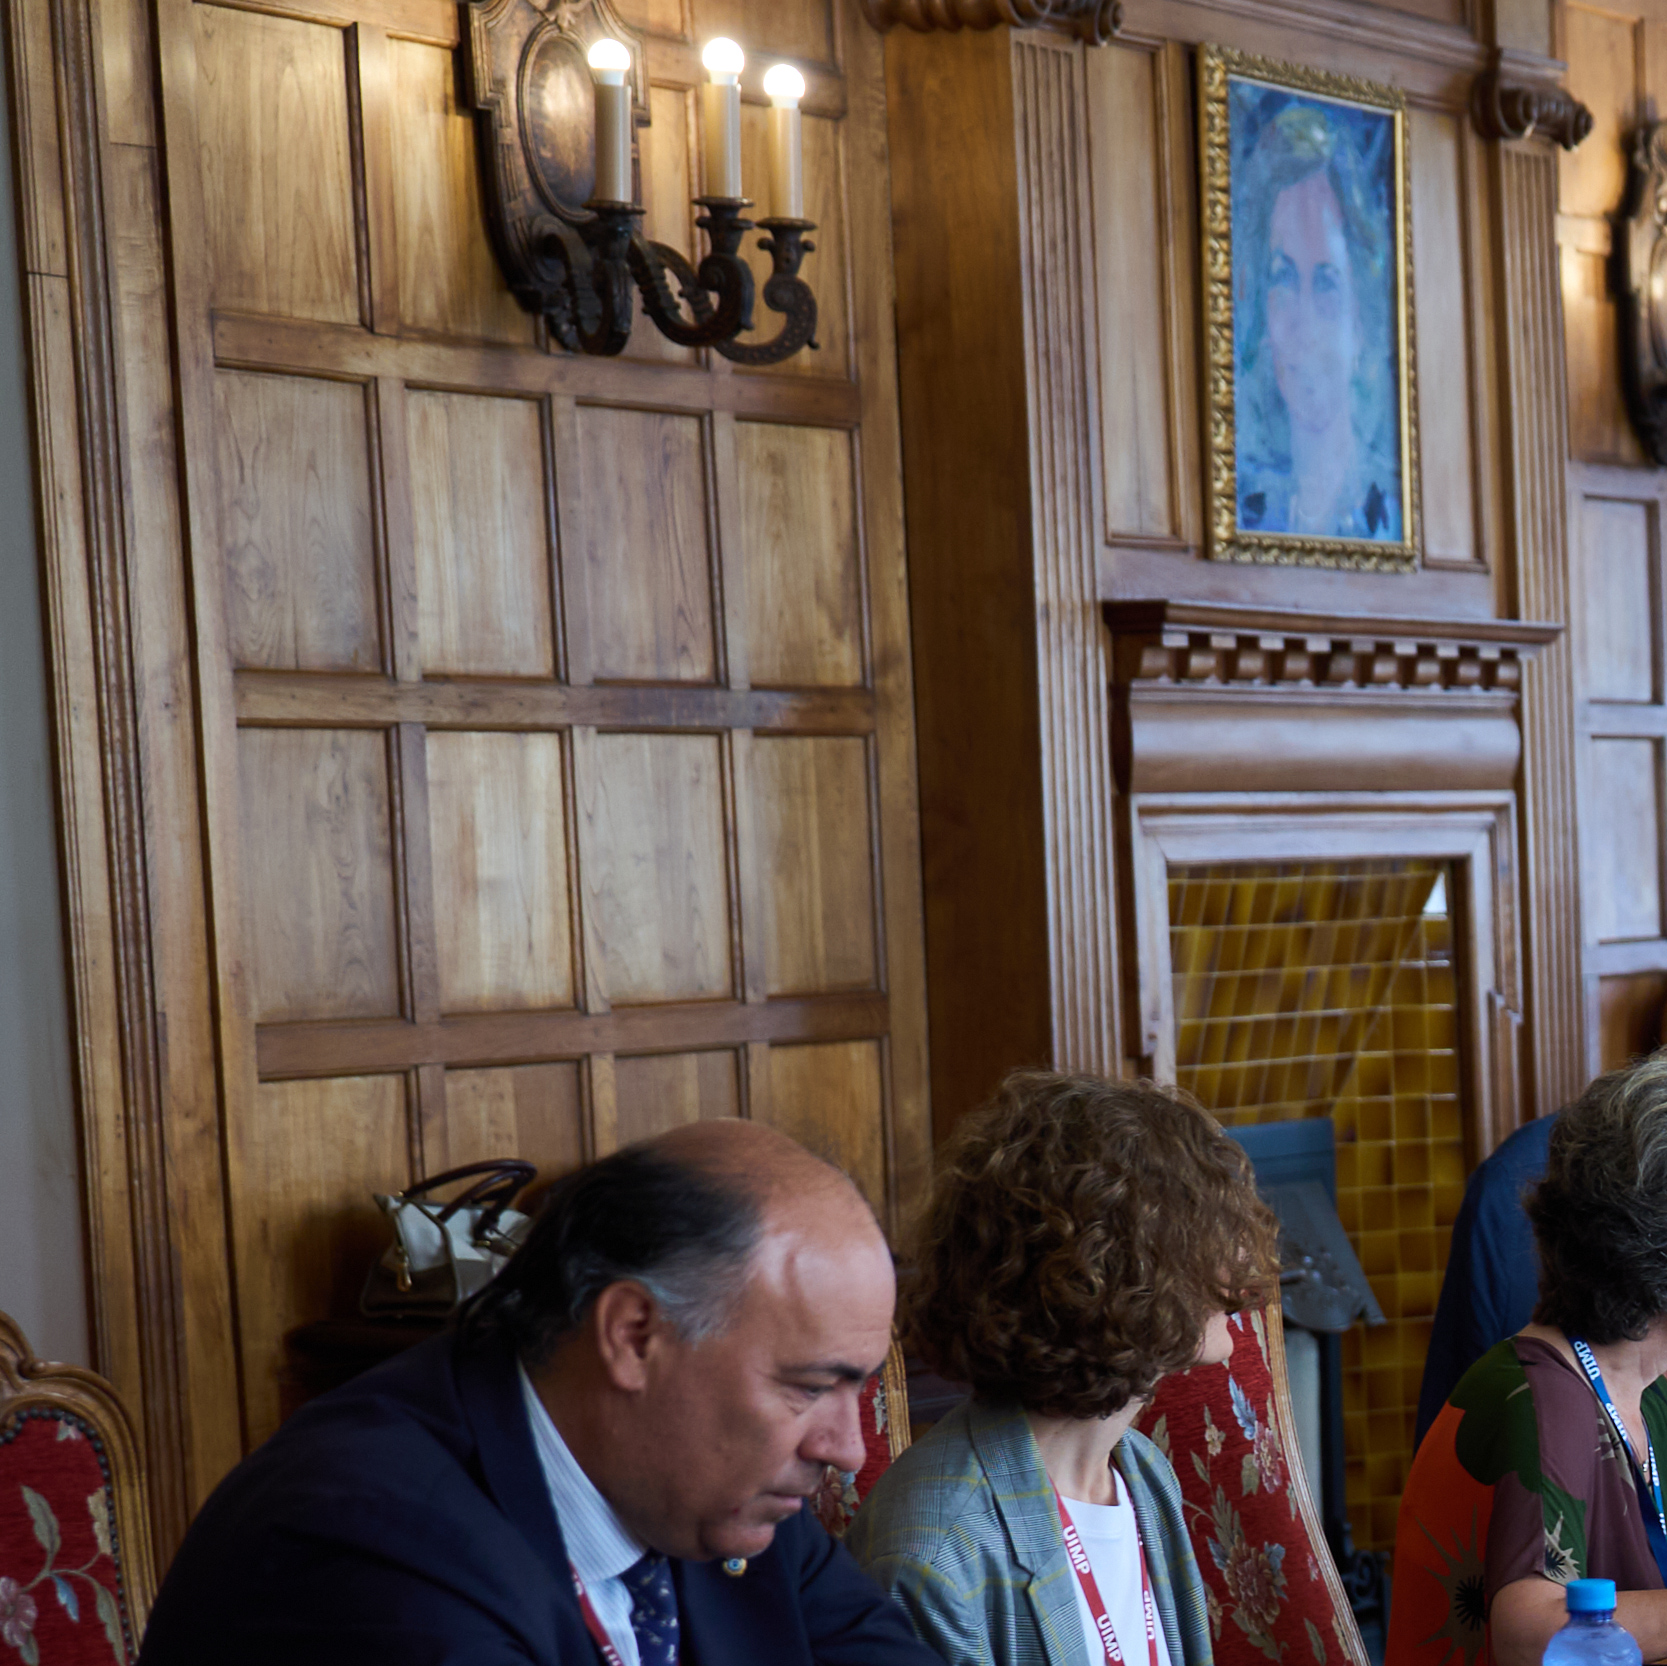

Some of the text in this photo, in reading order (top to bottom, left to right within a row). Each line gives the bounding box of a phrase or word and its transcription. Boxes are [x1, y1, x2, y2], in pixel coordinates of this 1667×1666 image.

[1573, 1340, 1601, 1381] UIMP
[1063, 1524, 1091, 1575] UIMP
[1097, 1613, 1122, 1663] UIMP
[1143, 1590, 1155, 1641] UIMP
